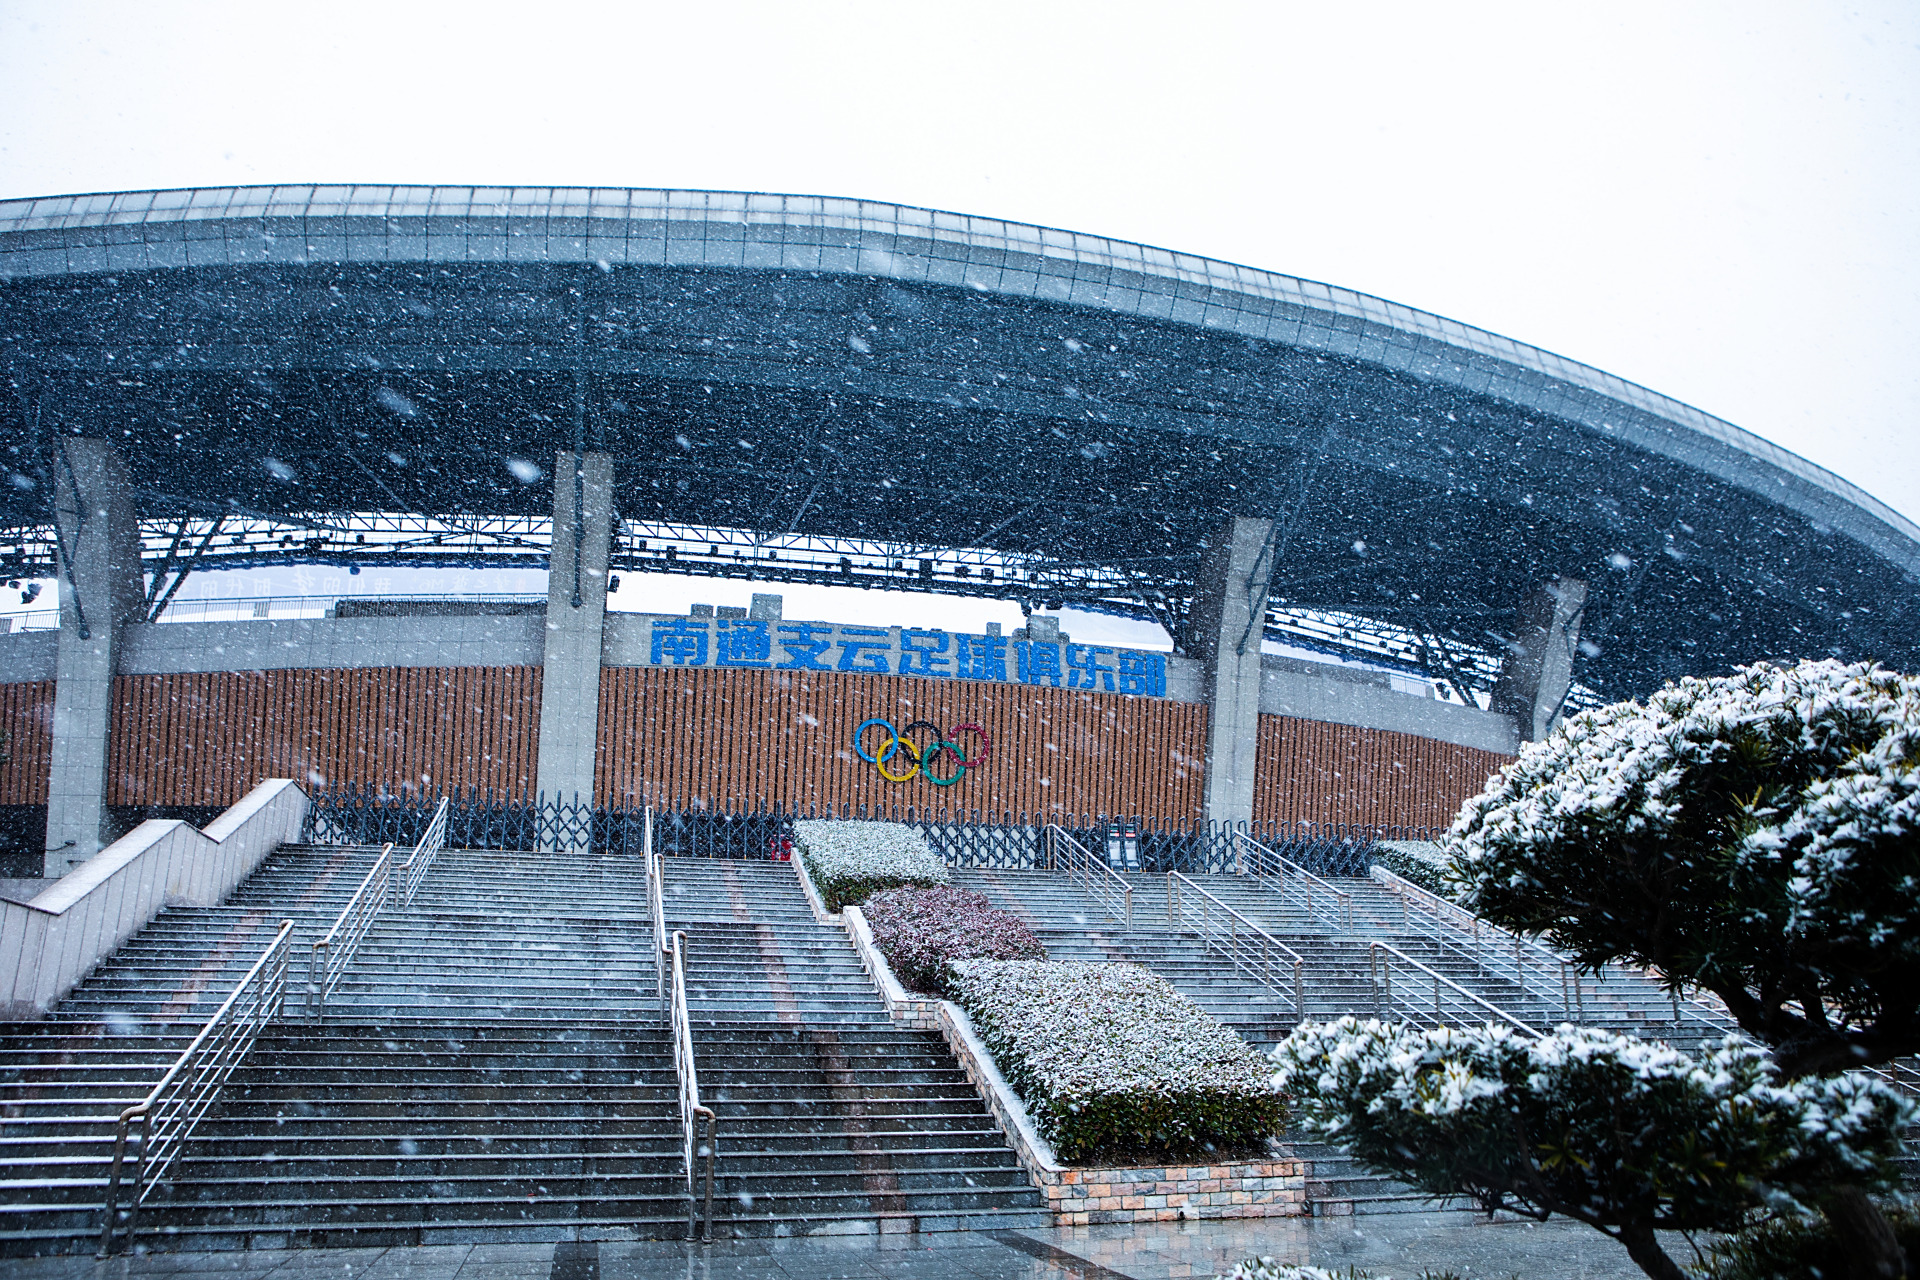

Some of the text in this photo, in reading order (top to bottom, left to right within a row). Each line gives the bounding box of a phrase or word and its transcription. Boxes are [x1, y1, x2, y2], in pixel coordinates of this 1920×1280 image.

[650, 618, 1167, 697] 南通支云足球俱乐部
